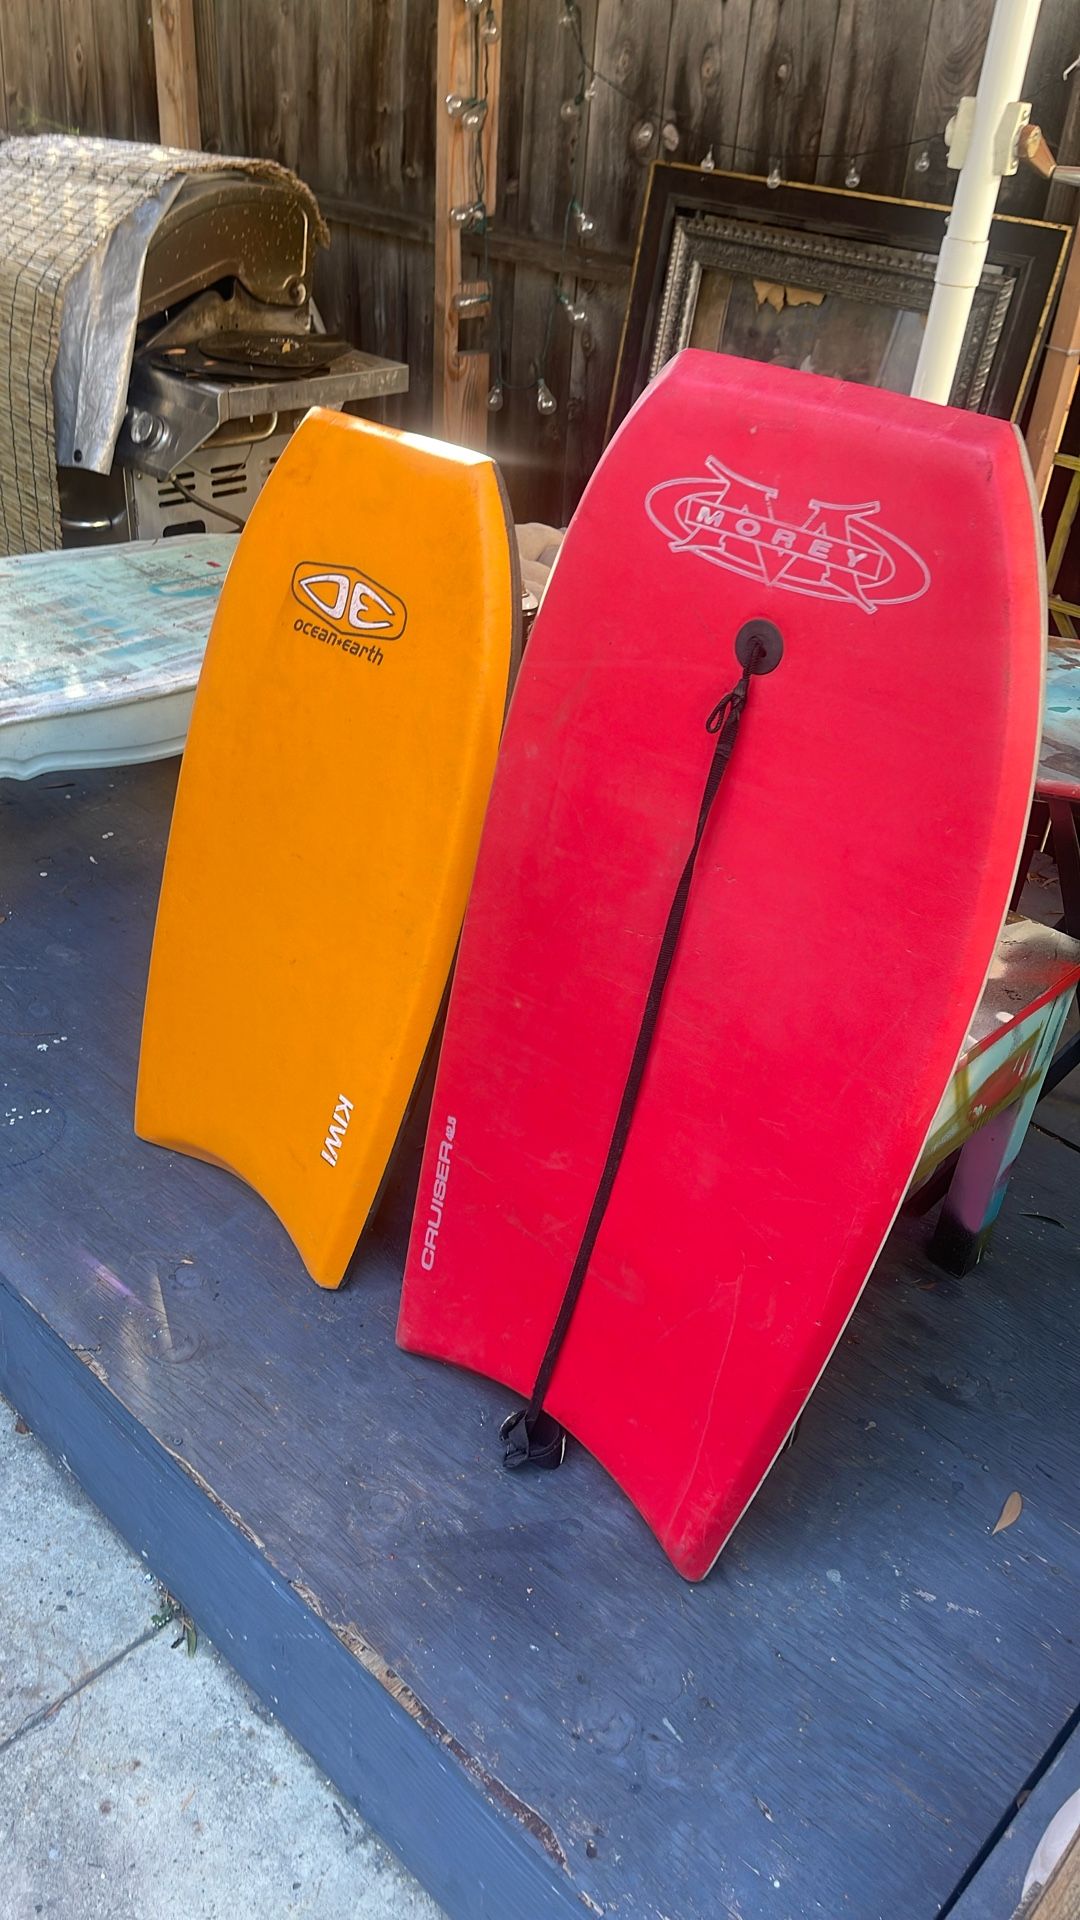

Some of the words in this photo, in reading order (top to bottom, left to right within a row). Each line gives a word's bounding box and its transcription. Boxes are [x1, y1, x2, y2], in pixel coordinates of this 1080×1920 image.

[695, 505, 868, 569] MOREY
[320, 1093, 354, 1168] KIWI
[421, 1139, 454, 1271] CRUISER
